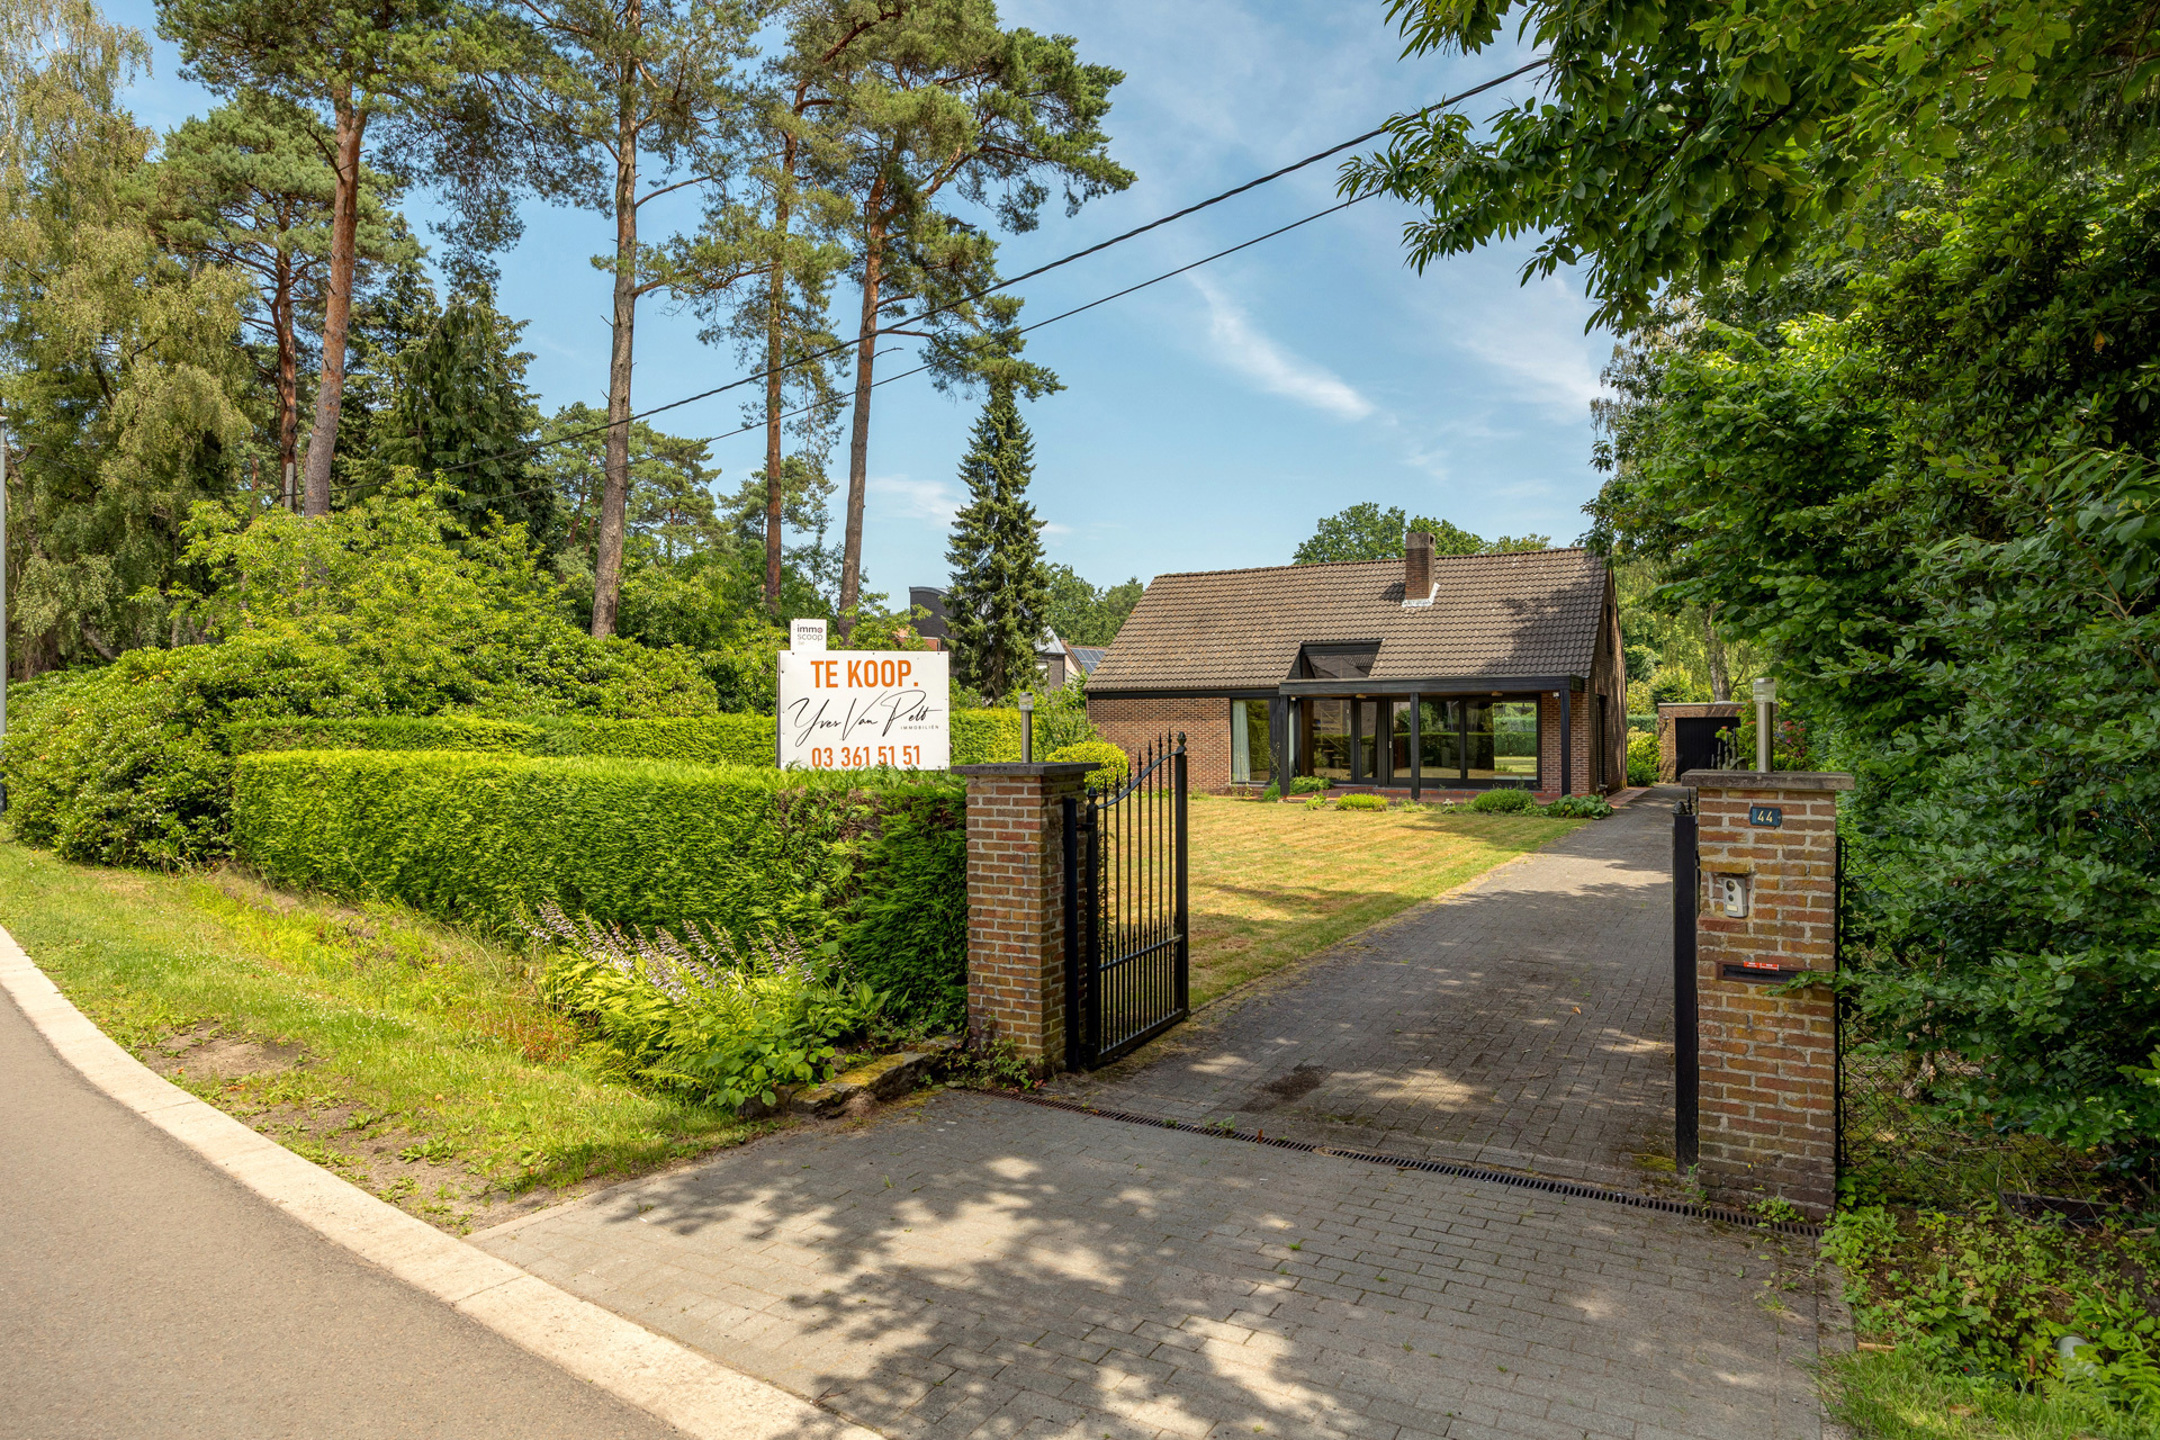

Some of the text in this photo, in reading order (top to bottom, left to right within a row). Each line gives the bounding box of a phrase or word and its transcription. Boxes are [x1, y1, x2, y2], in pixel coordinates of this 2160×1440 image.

[797, 634, 823, 642] scoop
[810, 660, 919, 688] TE KOOP.
[788, 689, 943, 747] Yves Van Pelt
[811, 745, 920, 767] 03 361 51 51
[1757, 810, 1773, 823] 44
